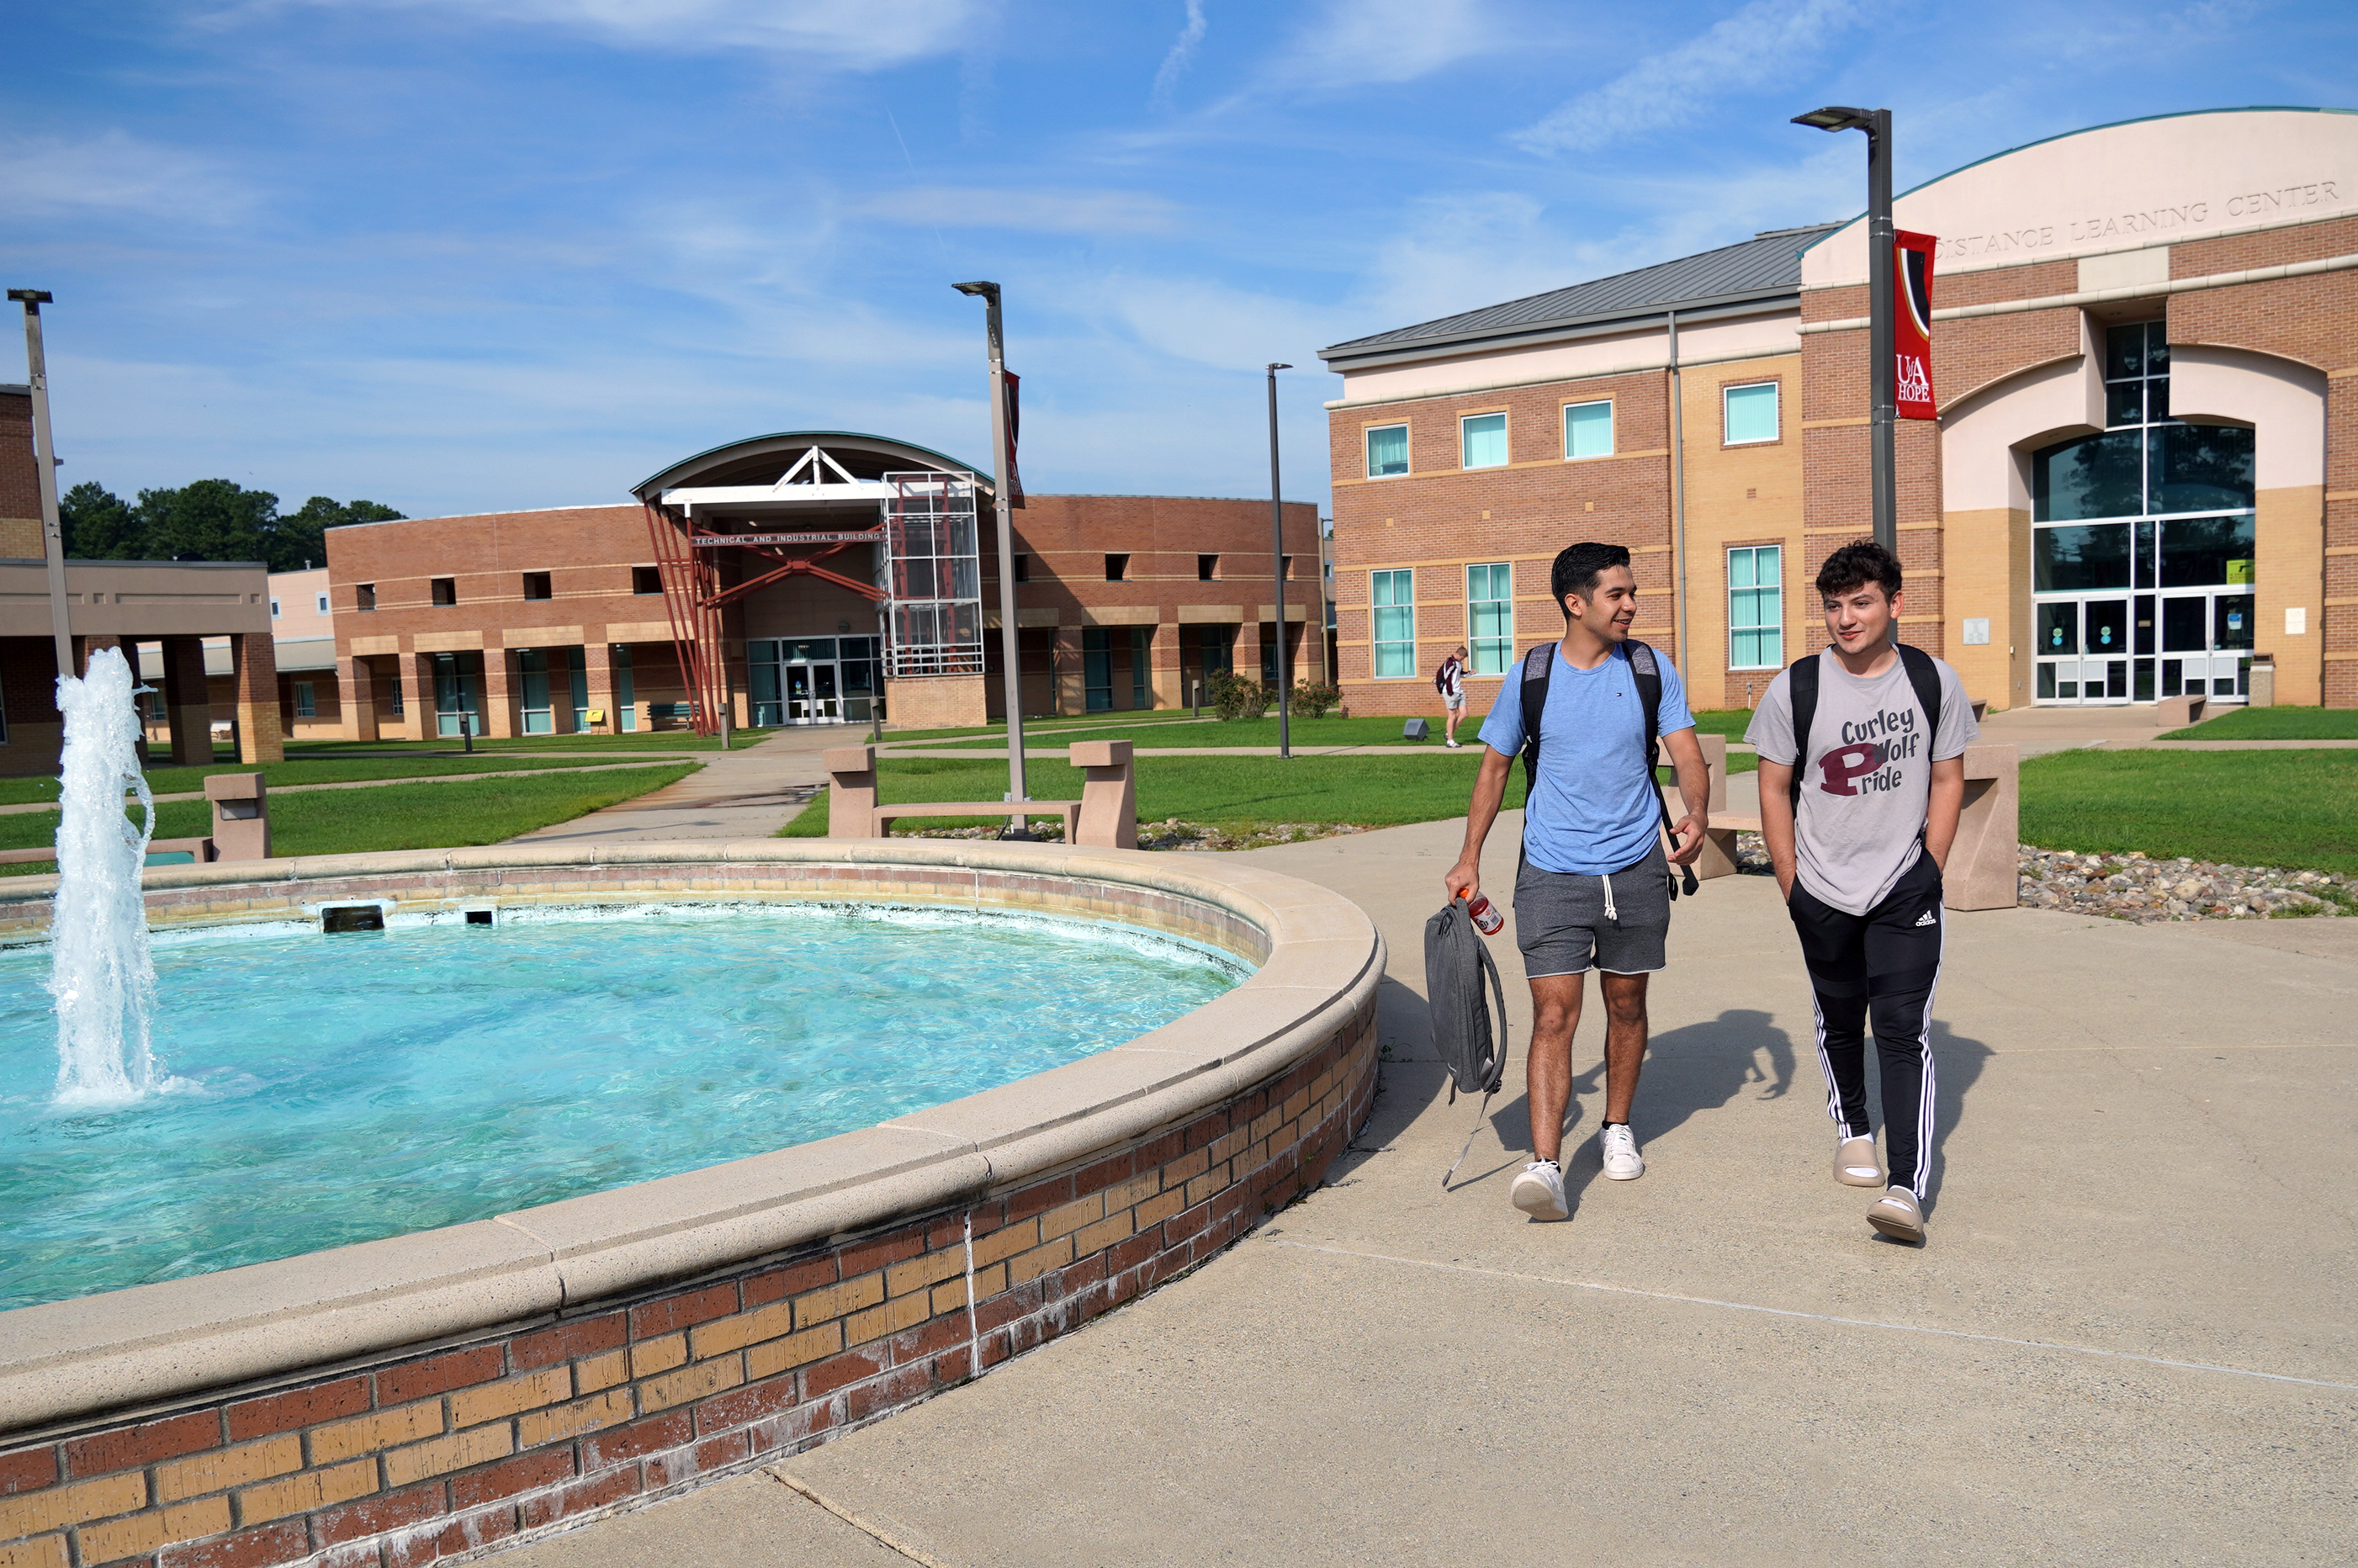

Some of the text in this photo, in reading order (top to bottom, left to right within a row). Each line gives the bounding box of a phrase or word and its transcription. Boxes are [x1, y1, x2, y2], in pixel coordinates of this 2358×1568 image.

[2070, 202, 2208, 241] LEARNING
[2226, 181, 2339, 216] CENTER
[1898, 384, 1930, 401] HOPE
[696, 537, 747, 545] TECHNICAL
[1841, 707, 1914, 744] Curley
[1872, 733, 1920, 765] Wolf
